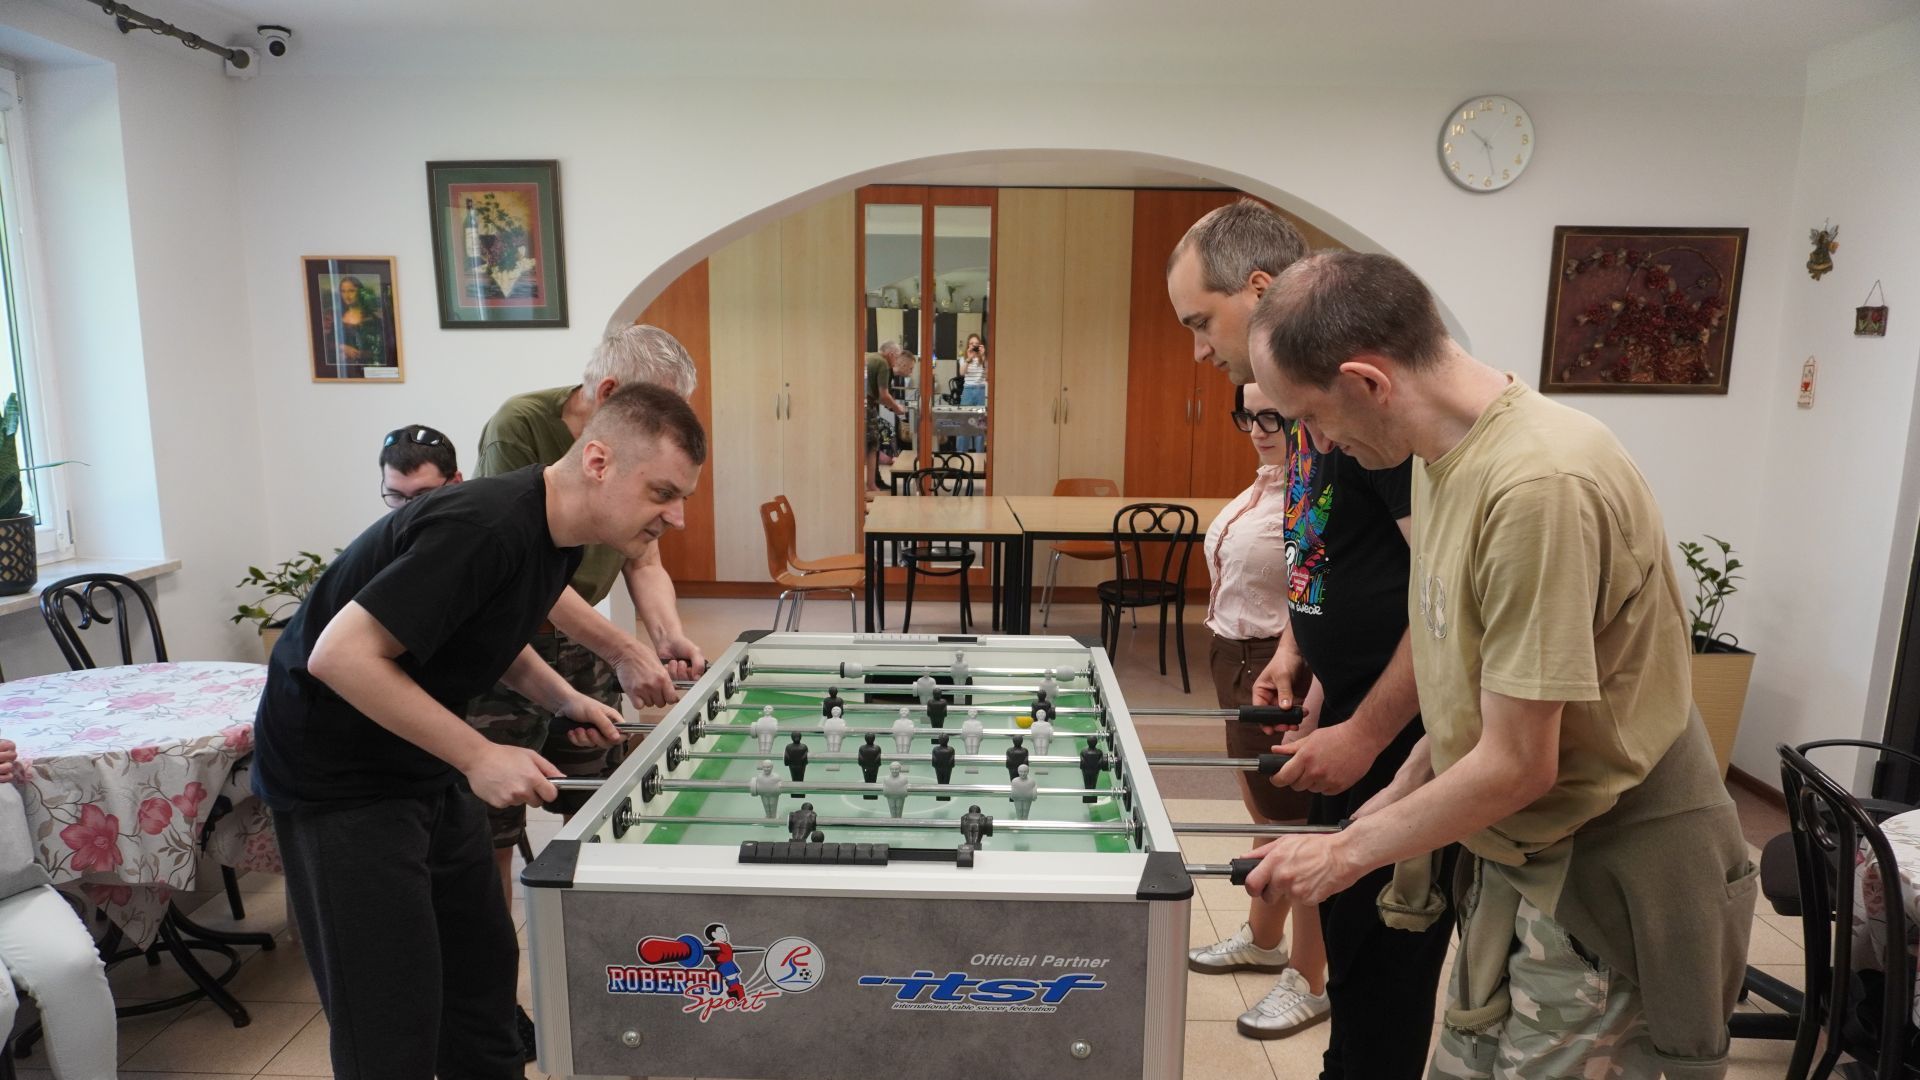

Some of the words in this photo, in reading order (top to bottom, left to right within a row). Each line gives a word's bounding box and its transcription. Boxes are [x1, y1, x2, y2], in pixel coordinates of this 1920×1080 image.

[1480, 100, 1493, 112] 12
[1501, 104, 1508, 114] 1
[1463, 110, 1476, 120] 11
[1515, 115, 1522, 127] 2
[1451, 124, 1465, 136] 10
[1502, 168, 1510, 181] 5
[1483, 176, 1493, 188] 6
[970, 953, 1037, 967] Official
[1041, 955, 1110, 968] Partner
[607, 967, 724, 994] ROBERTO
[859, 970, 1107, 1004] itsf
[682, 983, 781, 1021] Sport
[893, 1002, 950, 1010] international
[952, 1003, 975, 1011] table
[1009, 1004, 1056, 1013] federation
